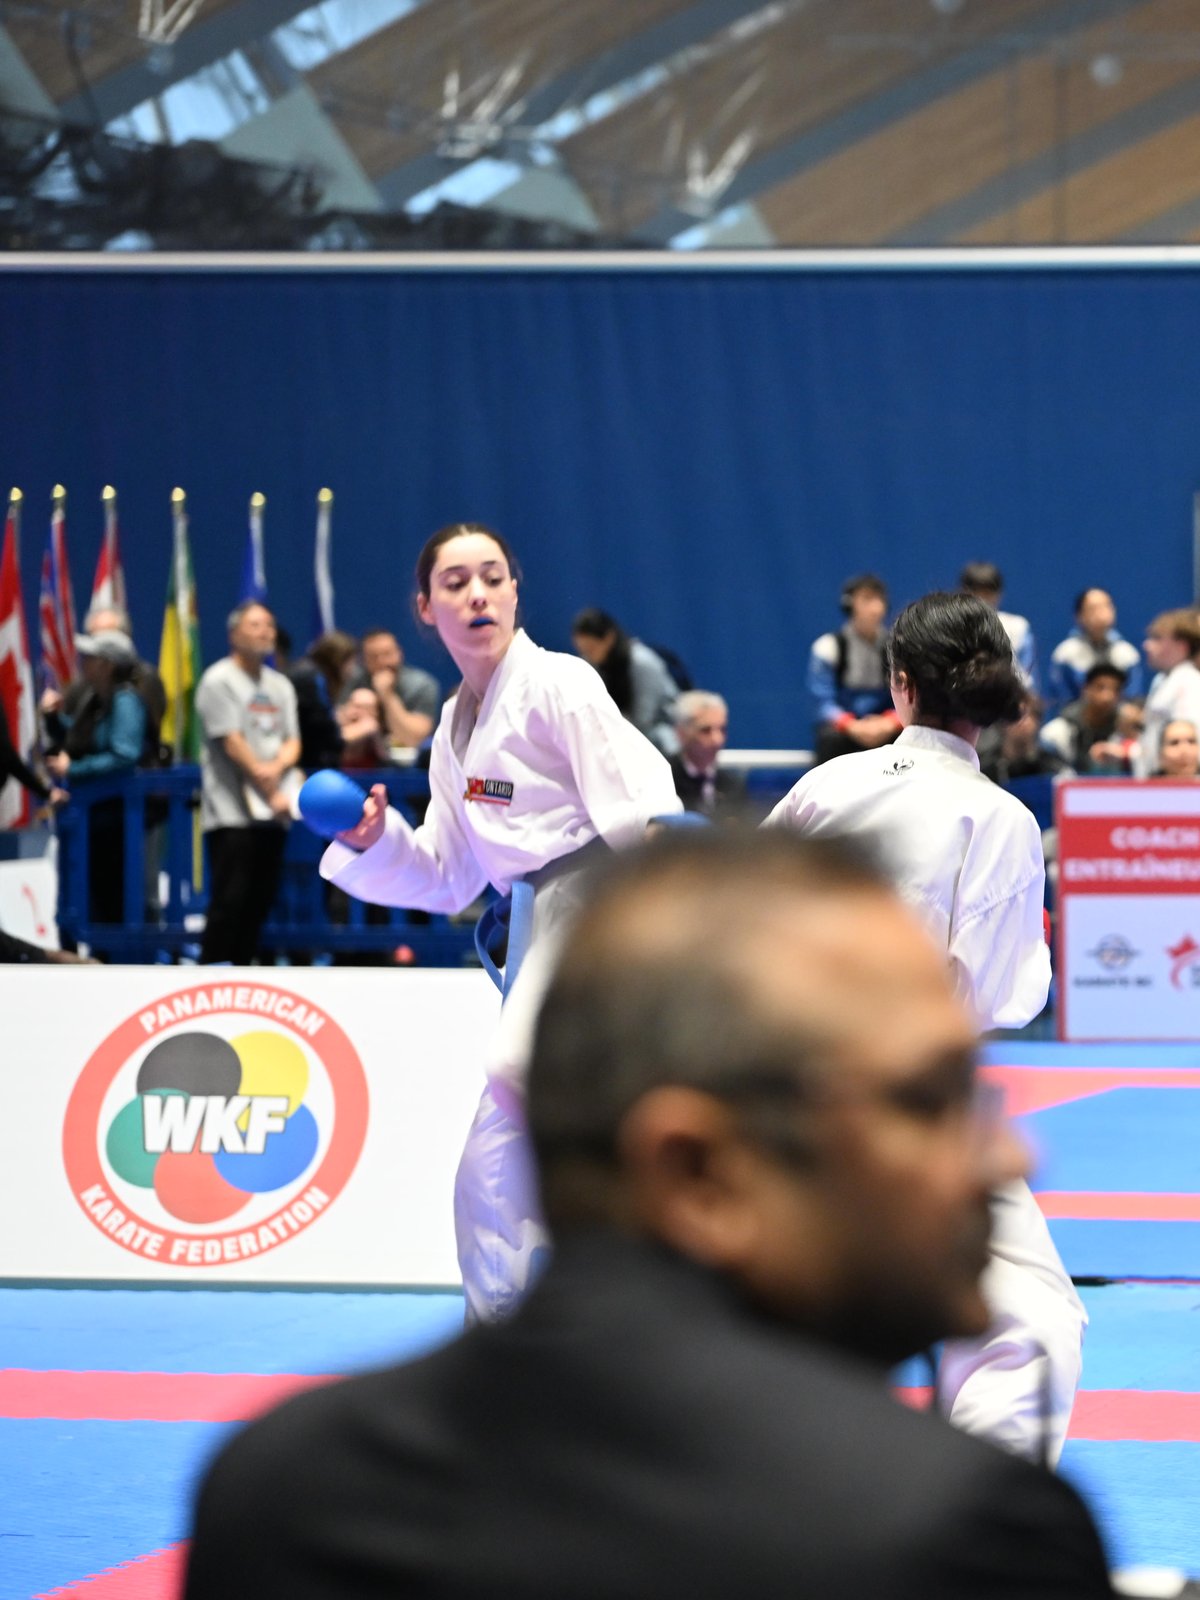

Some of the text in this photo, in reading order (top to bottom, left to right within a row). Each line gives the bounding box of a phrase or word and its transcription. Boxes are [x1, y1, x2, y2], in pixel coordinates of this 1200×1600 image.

[138, 986, 327, 1038] PANAMERICAN
[142, 1094, 290, 1155] WKF
[79, 1183, 330, 1263] KARATE FEDERATION
